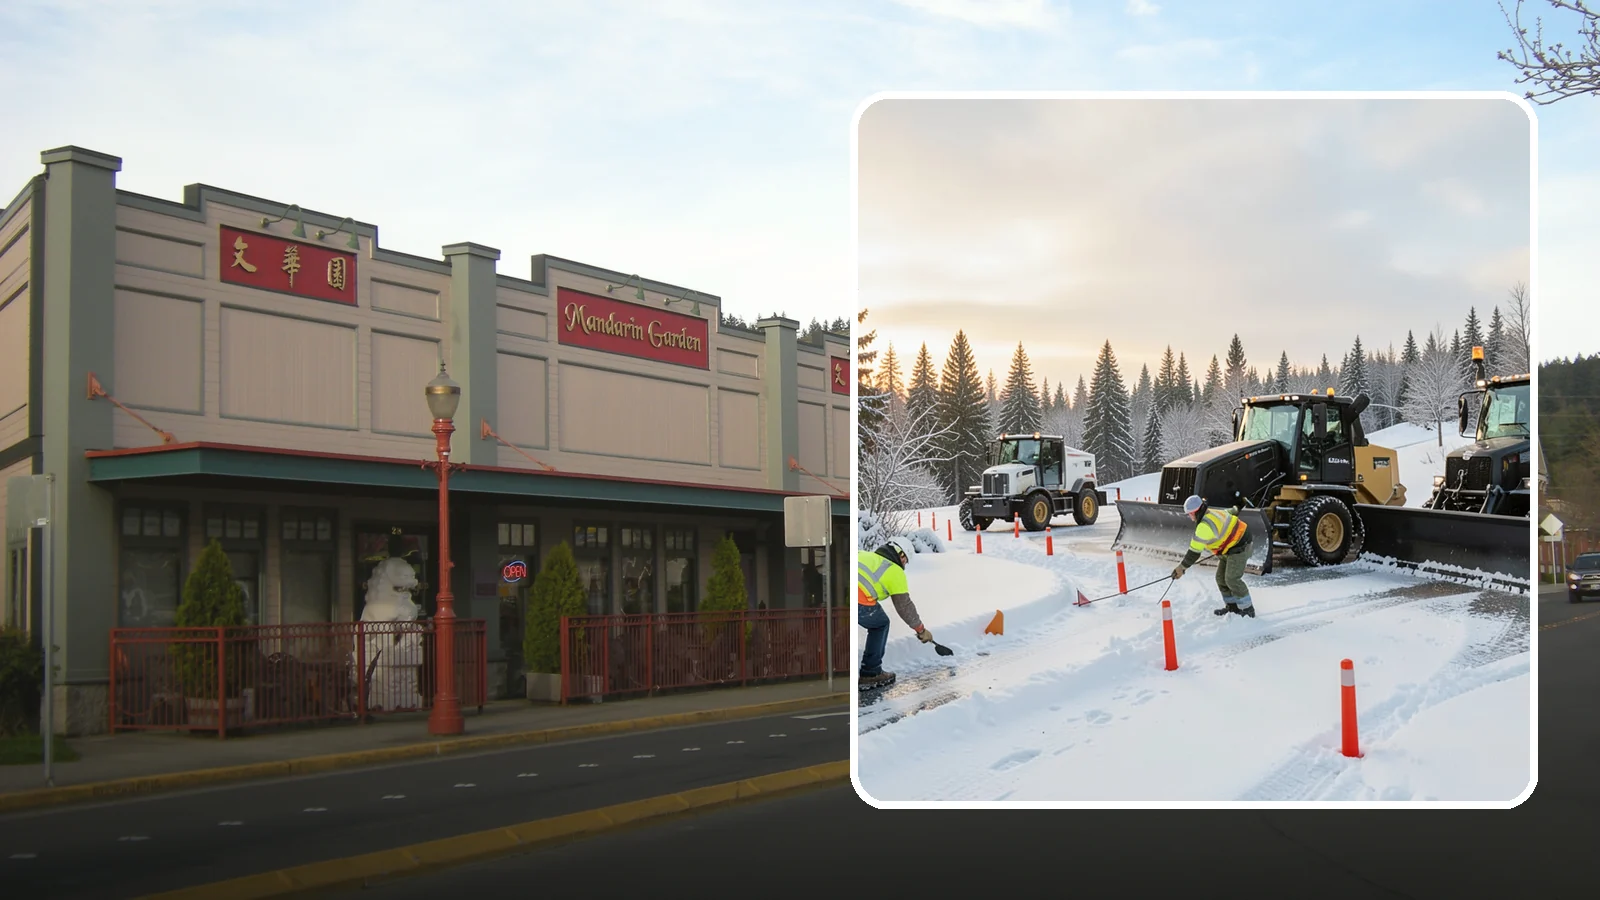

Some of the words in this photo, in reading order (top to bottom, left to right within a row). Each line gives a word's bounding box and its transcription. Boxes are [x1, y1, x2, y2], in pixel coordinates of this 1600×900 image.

[231, 236, 346, 291] 文華園
[564, 302, 644, 341] Mandarin
[648, 320, 701, 351] Garden
[503, 565, 527, 578] OPEN
